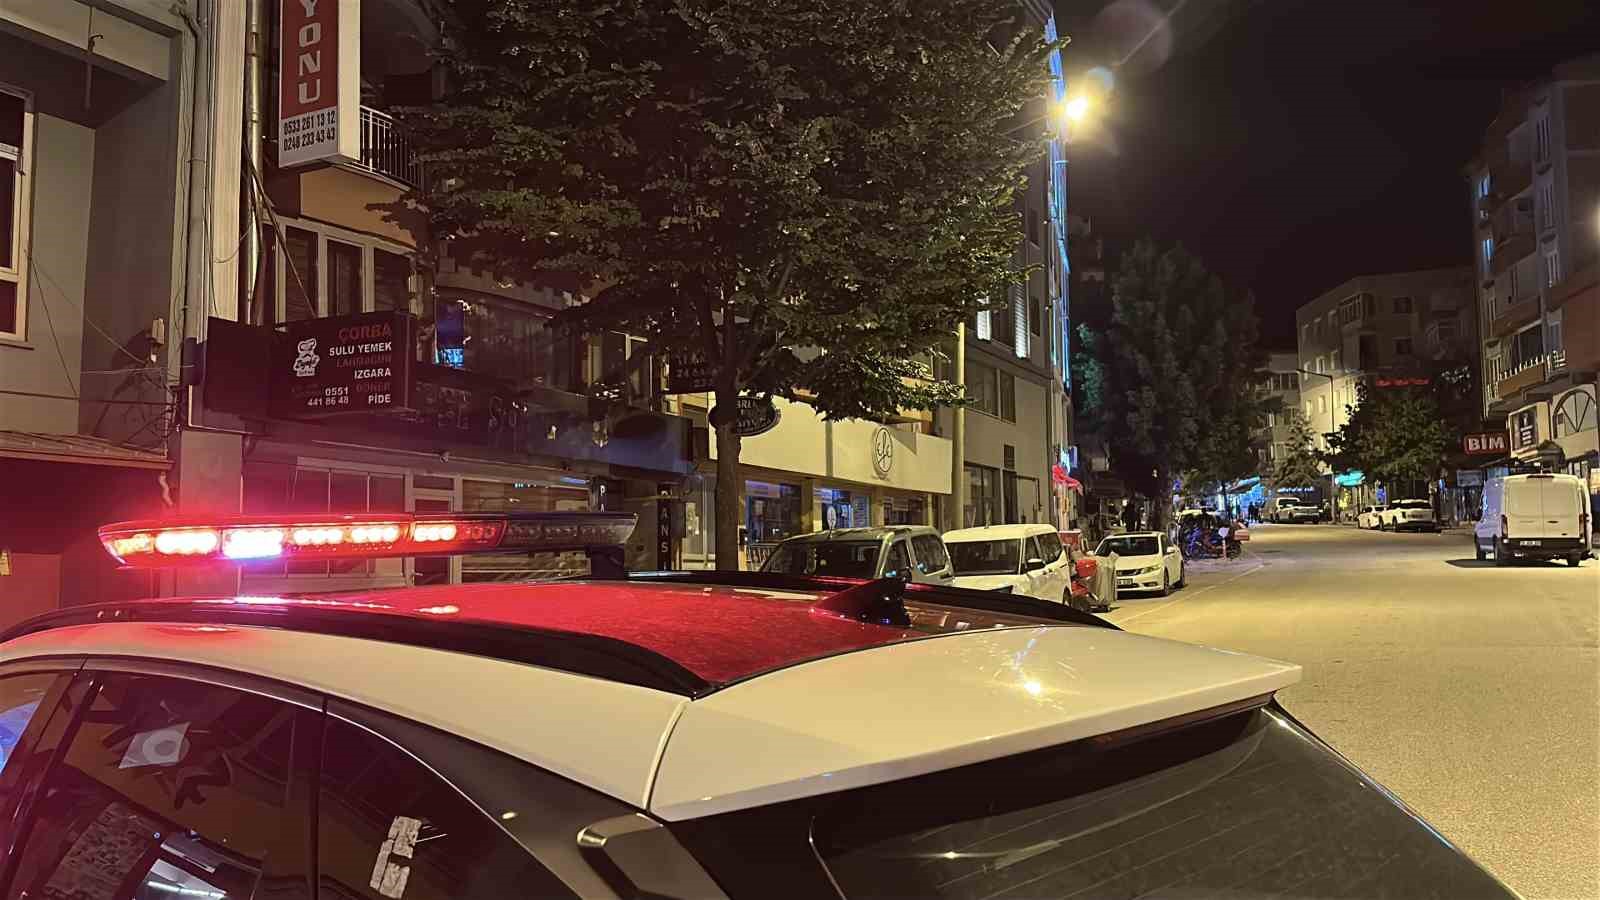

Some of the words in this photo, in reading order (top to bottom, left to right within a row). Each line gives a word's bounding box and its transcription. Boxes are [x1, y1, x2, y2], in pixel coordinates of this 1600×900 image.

[284, 119, 301, 136] 0533
[302, 115, 314, 131] 261
[317, 112, 325, 127] 13
[327, 110, 336, 124] 12
[302, 131, 315, 146] 233
[316, 129, 325, 143] 43
[327, 126, 336, 140] 43
[329, 345, 355, 356] SULU
[358, 342, 392, 353] YEMEK
[354, 367, 391, 379] IZGARA
[325, 387, 348, 396] 0551
[307, 398, 323, 406] 441
[368, 393, 391, 404] PİDE
[1468, 434, 1505, 450] BİM
